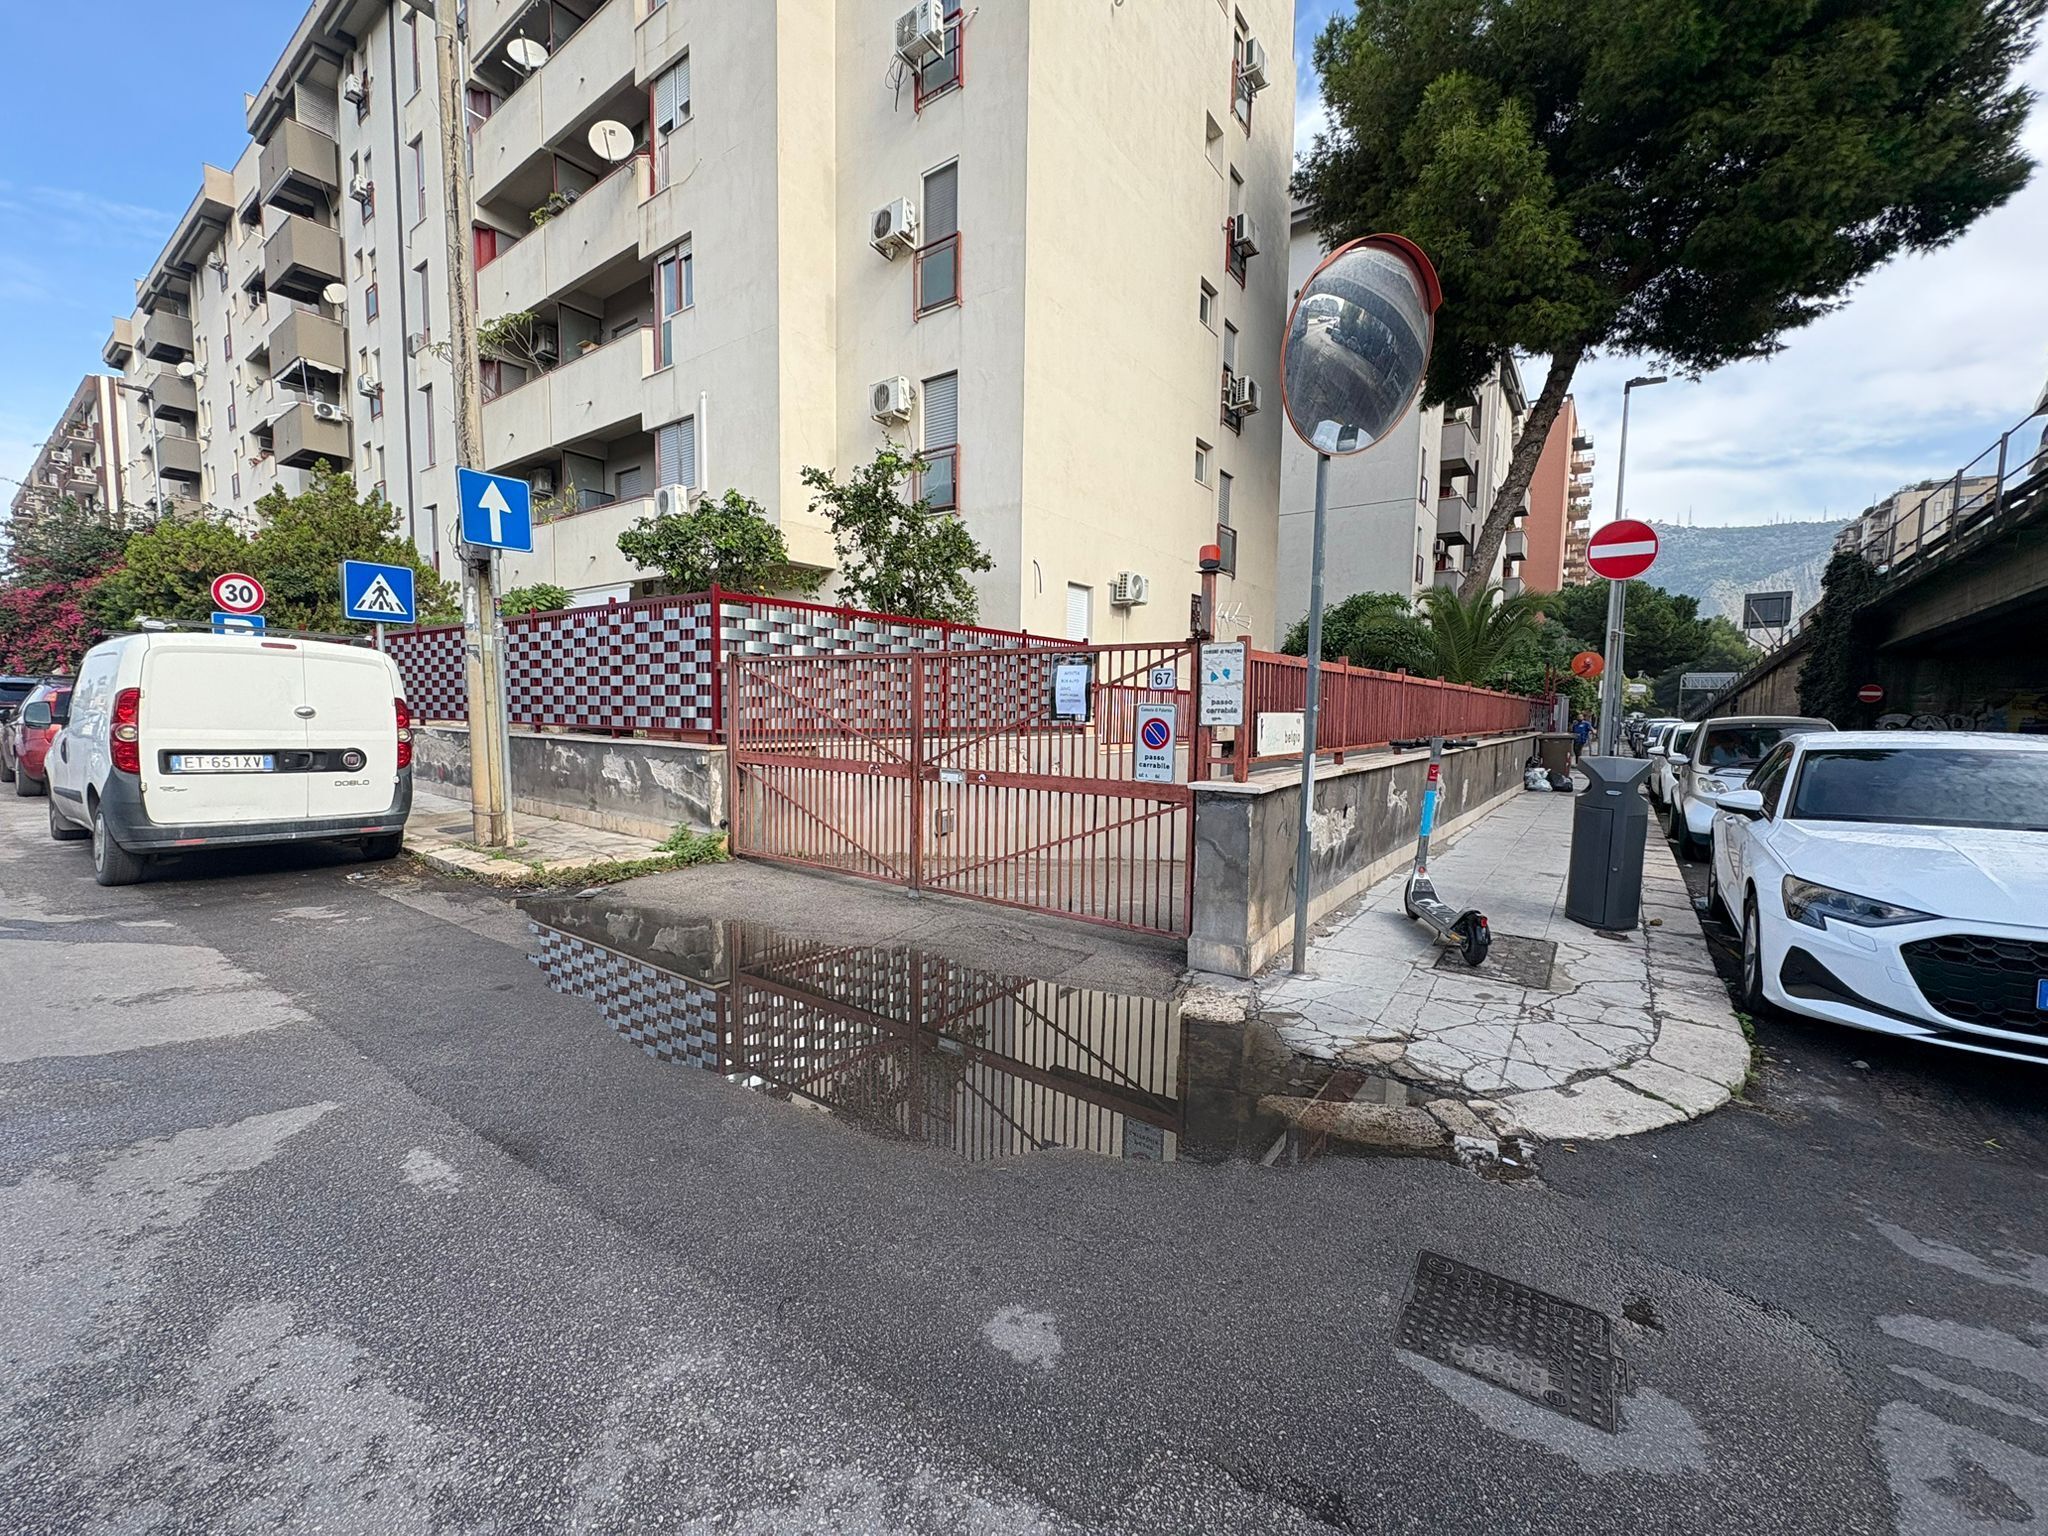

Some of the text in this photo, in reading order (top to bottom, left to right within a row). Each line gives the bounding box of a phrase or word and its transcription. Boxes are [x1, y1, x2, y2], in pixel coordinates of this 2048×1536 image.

[225, 584, 253, 603] 30
[1155, 673, 1171, 685] 67
[1139, 762, 1170, 770] carrabile
